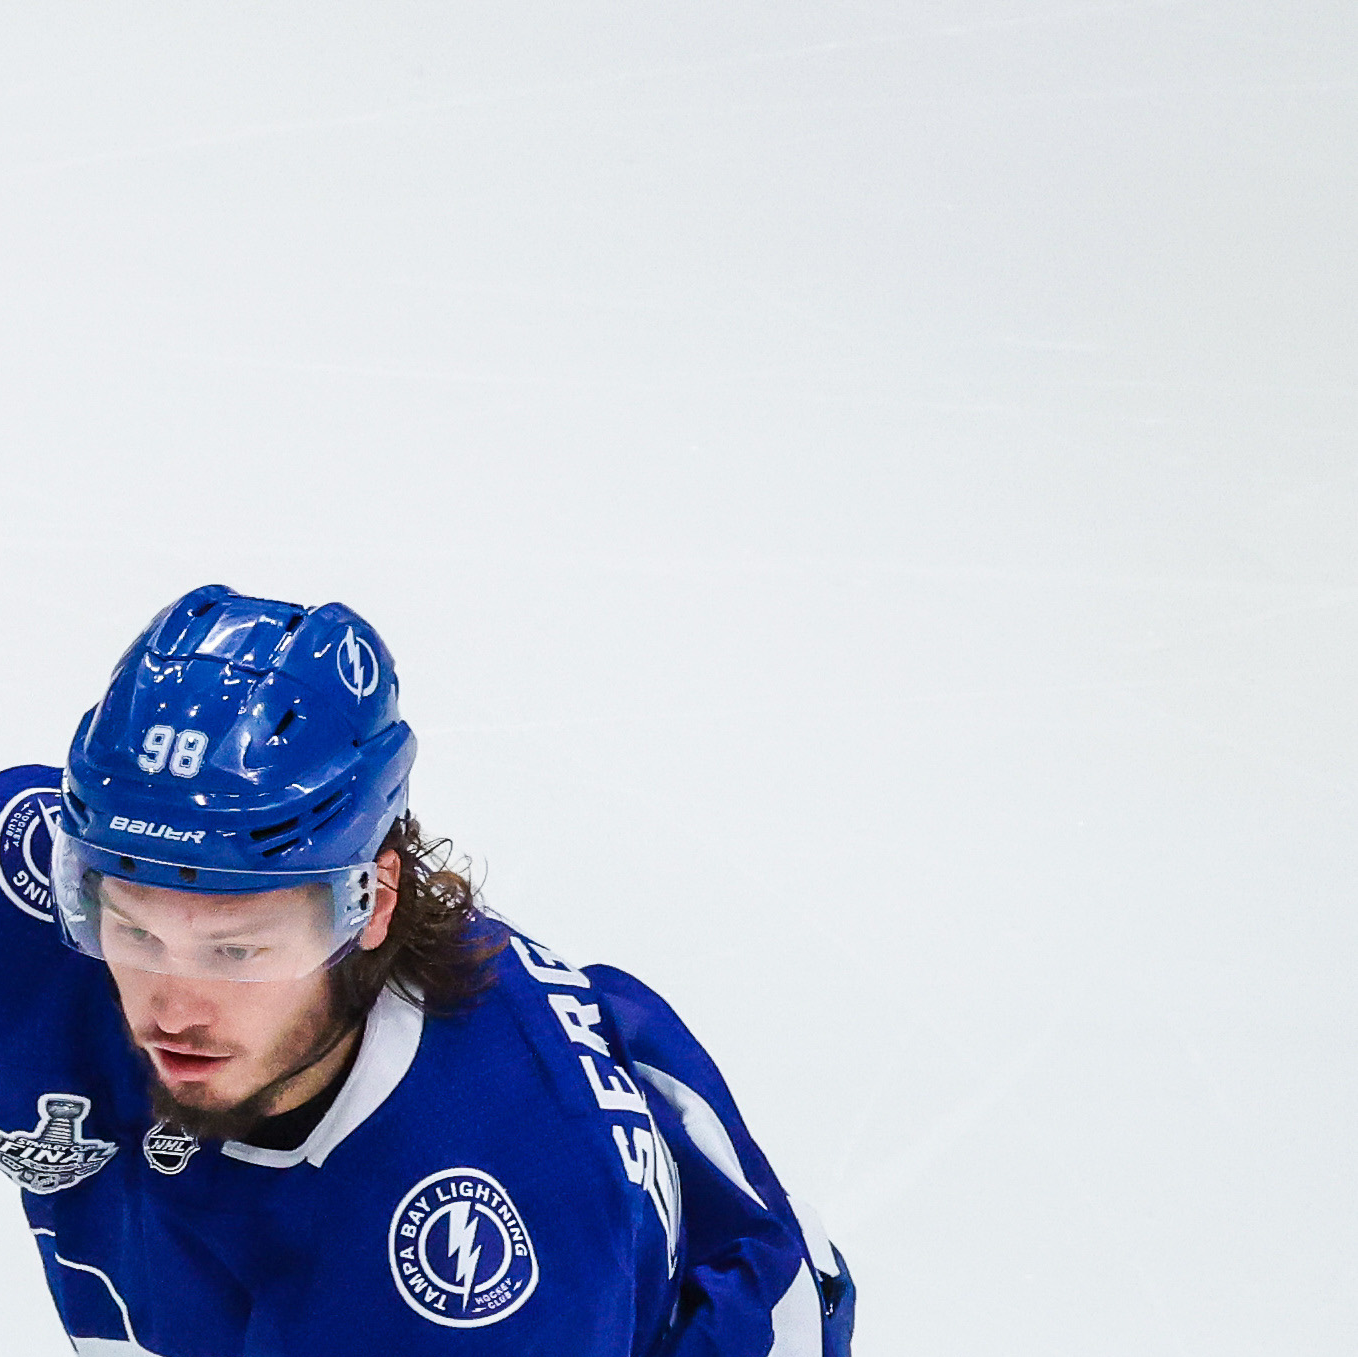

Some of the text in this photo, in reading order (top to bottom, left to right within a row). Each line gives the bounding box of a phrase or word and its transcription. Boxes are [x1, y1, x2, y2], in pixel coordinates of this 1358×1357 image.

[137, 724, 210, 779] 98
[150, 1138, 185, 1152] NHL
[399, 1181, 529, 1311] TAMPA BAY LIGHTNING
[474, 1278, 512, 1305] HOCKEY
[487, 1291, 513, 1309] CLUB
